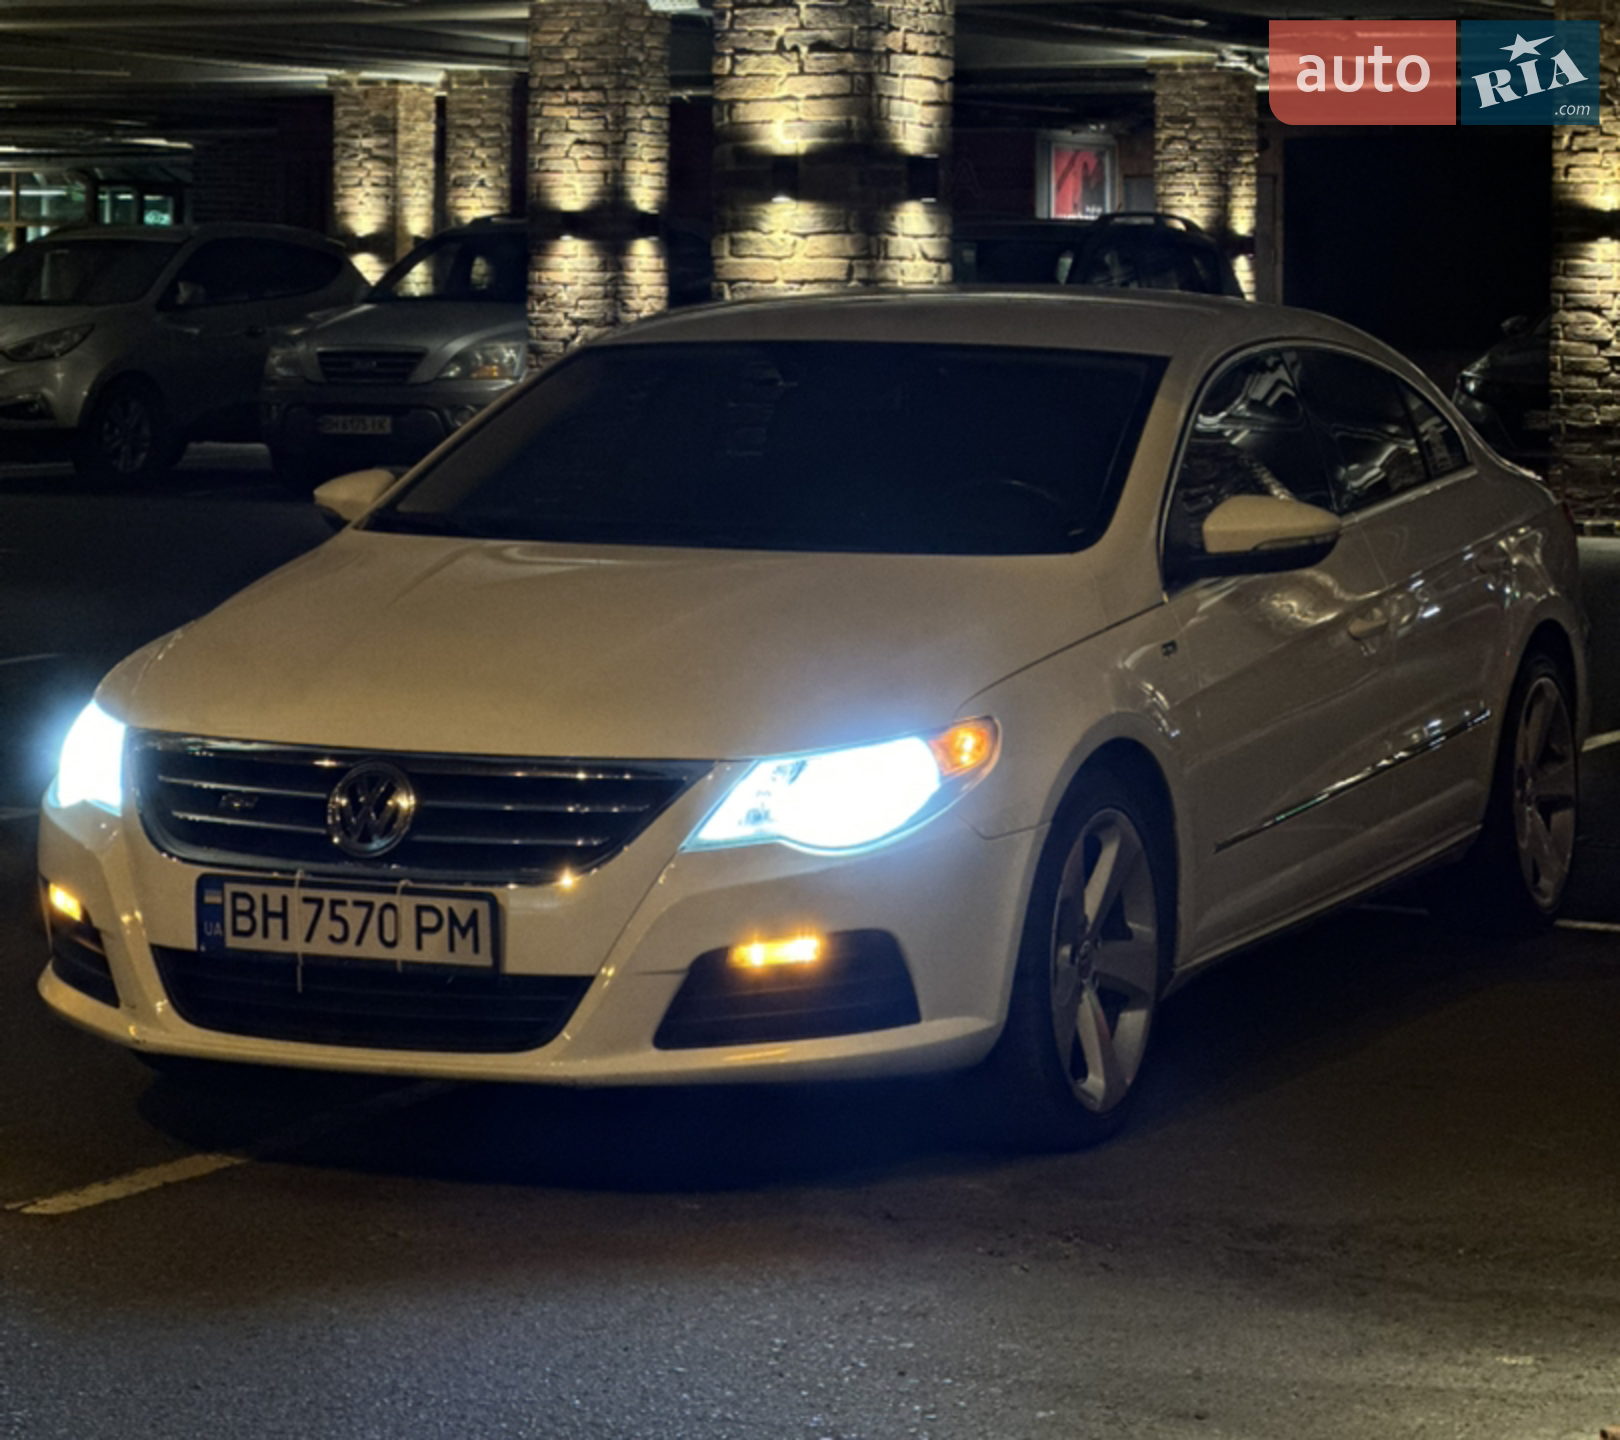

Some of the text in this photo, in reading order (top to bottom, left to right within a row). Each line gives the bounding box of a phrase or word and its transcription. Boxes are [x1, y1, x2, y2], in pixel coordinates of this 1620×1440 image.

[203, 921, 223, 936] UA
[230, 891, 481, 955] BH 7570 PM
